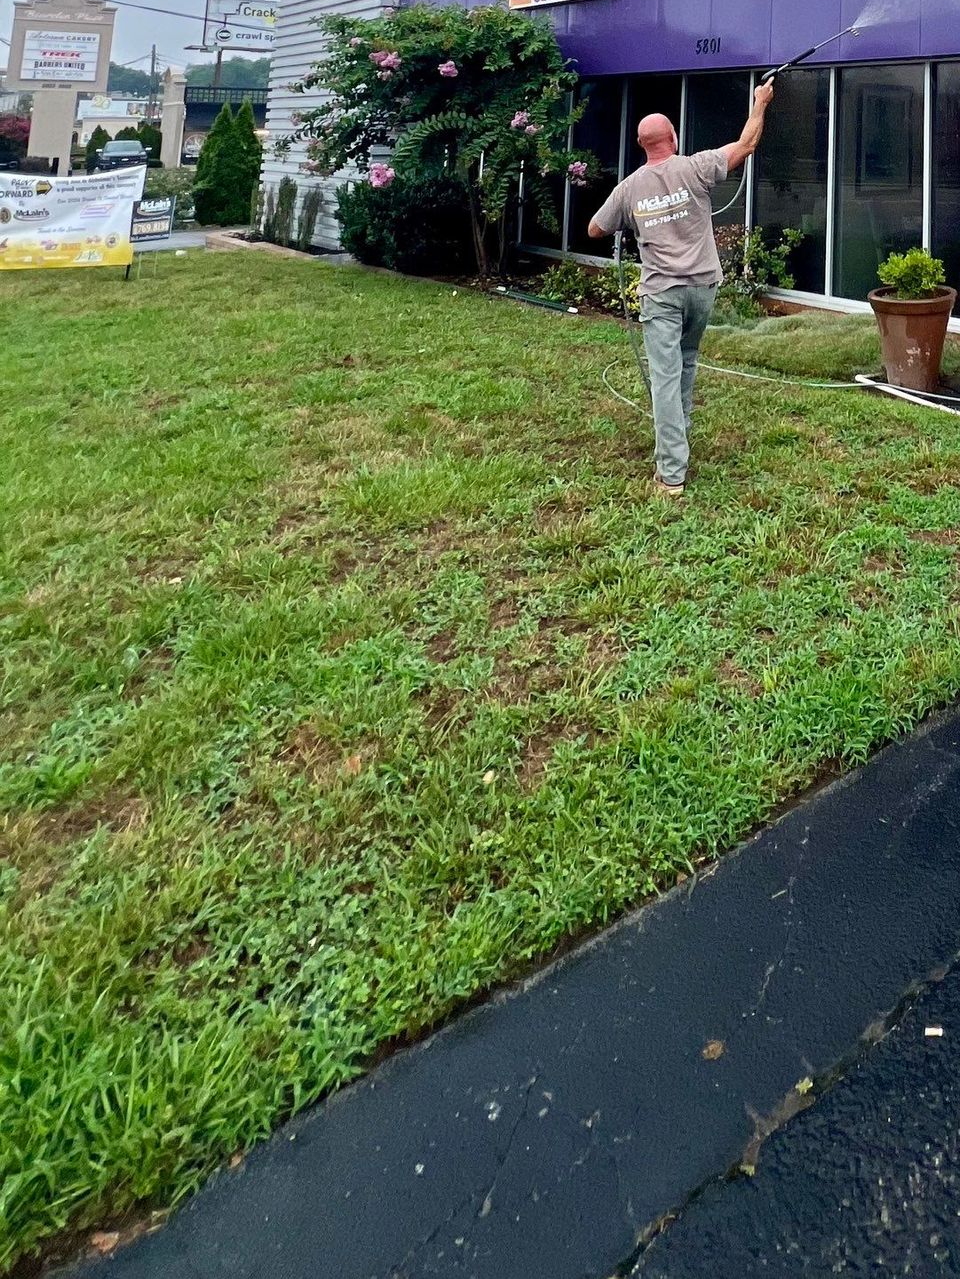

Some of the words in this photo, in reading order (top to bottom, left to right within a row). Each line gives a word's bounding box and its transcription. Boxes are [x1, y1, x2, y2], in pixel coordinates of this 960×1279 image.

[243, 6, 277, 18] Crack
[235, 32, 262, 40] crawl
[695, 36, 721, 56] 5801
